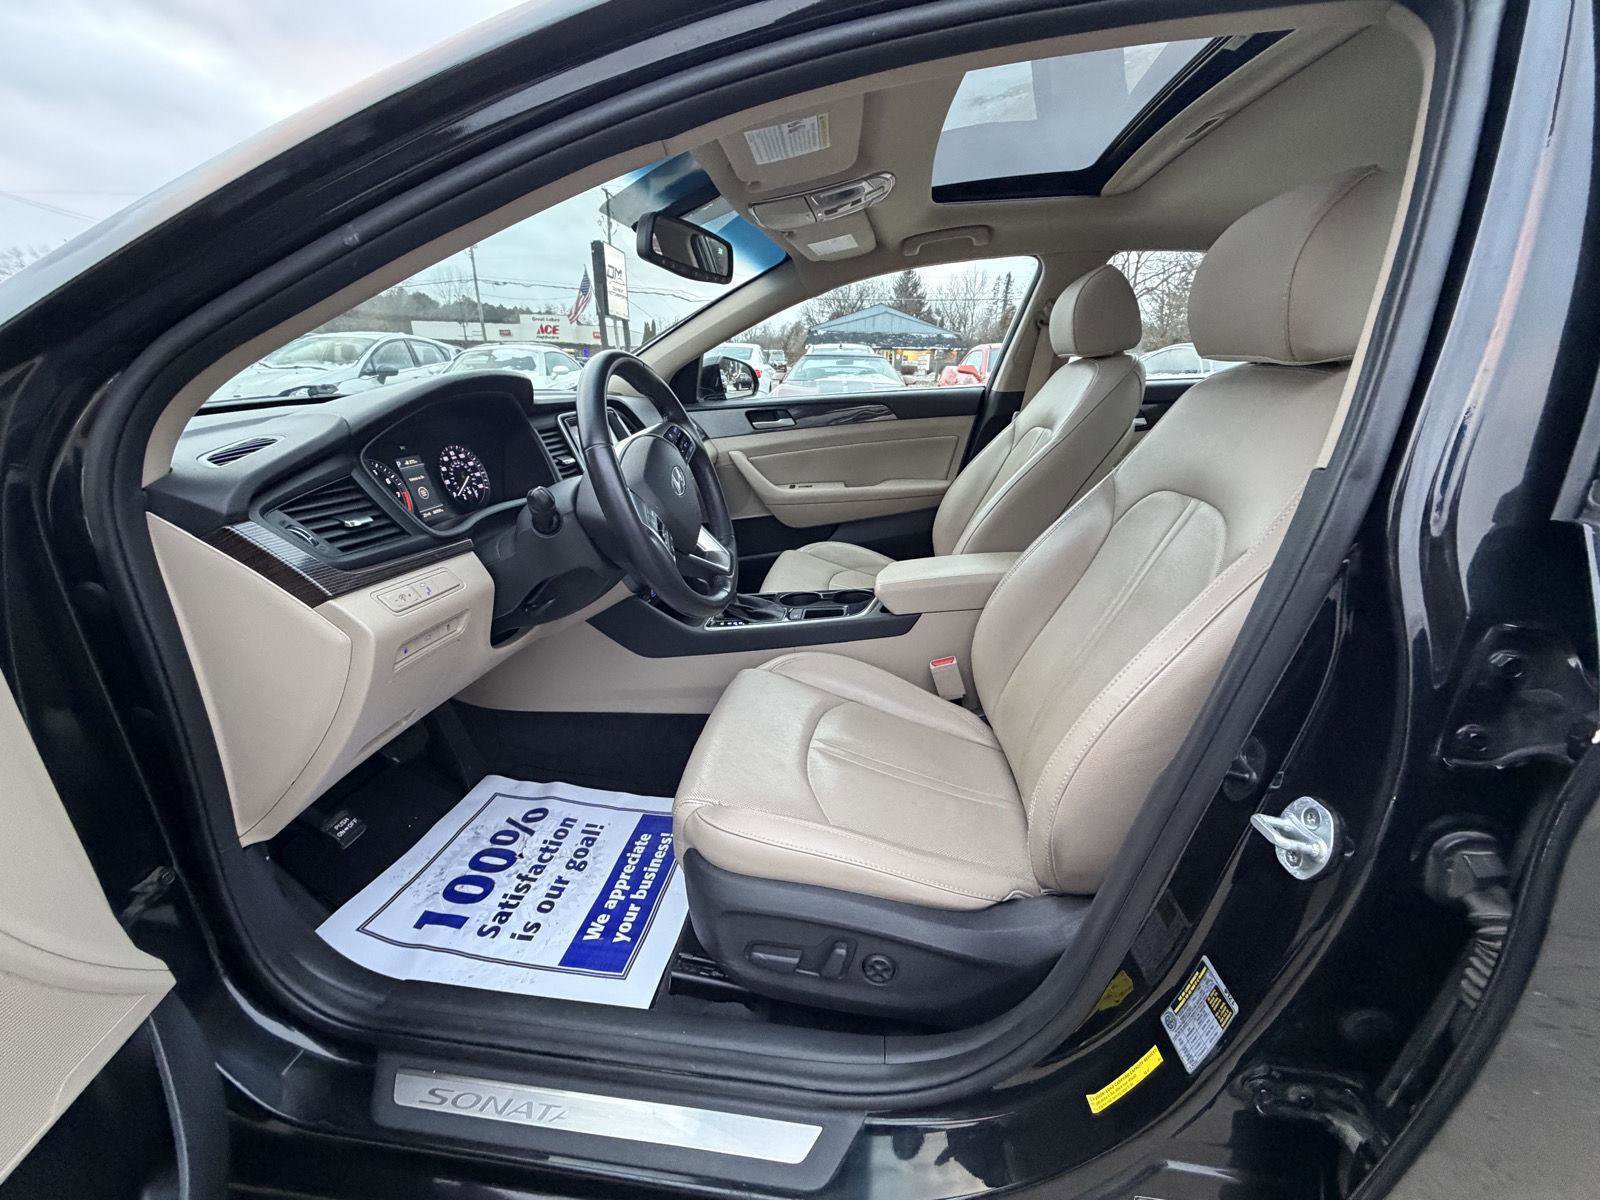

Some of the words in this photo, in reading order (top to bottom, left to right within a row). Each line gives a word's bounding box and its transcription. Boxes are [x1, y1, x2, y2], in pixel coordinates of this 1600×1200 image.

[536, 324, 559, 335] ACE
[334, 817, 350, 831] PUSH
[412, 806, 549, 931] 100%
[476, 816, 579, 940] Satisfaction
[510, 920, 542, 942] is
[536, 877, 571, 914] our
[565, 823, 605, 873] goal!
[582, 912, 608, 942] We
[604, 832, 652, 911] appreciate
[611, 903, 641, 944] your
[637, 831, 674, 901] business!
